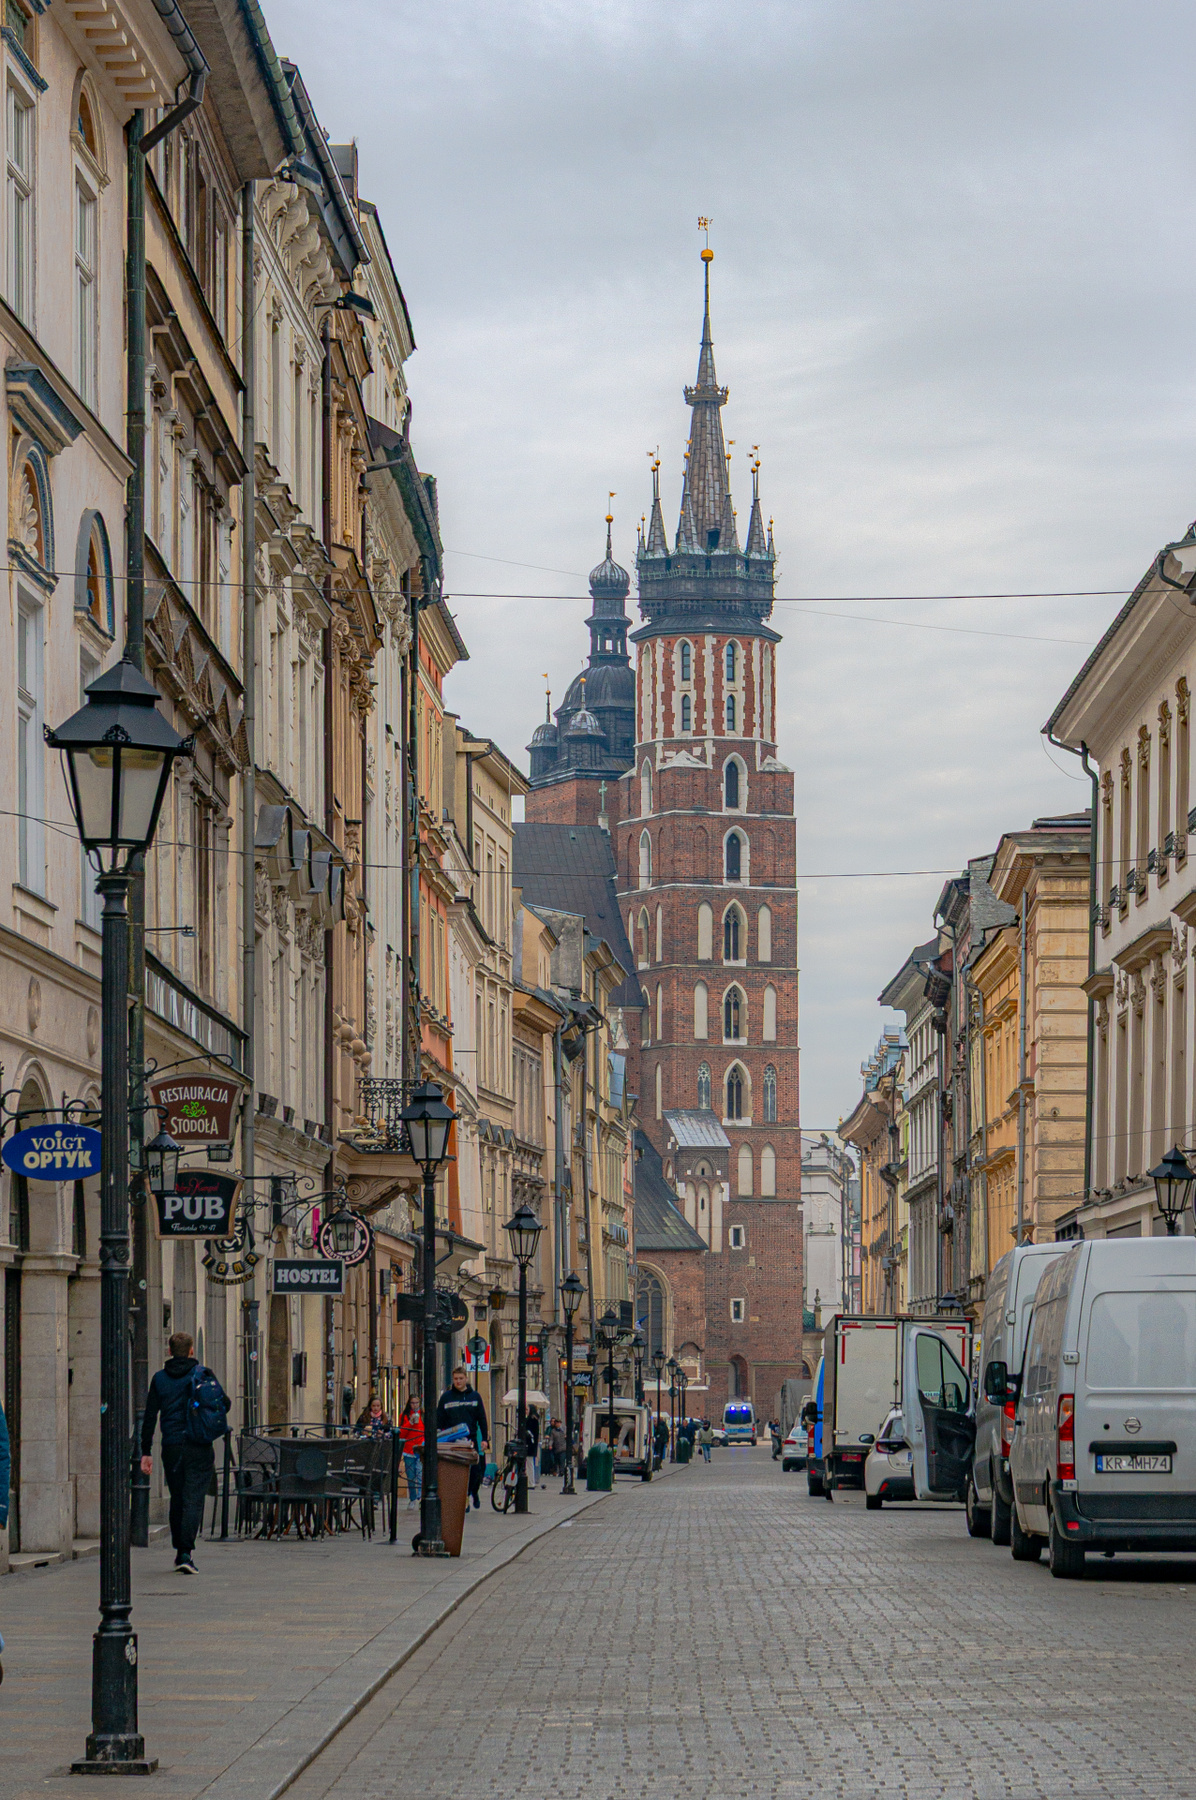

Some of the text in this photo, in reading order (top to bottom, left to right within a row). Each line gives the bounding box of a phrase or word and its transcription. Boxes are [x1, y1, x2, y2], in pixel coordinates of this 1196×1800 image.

[159, 1086, 228, 1104] RESTAURACJA
[170, 1116, 219, 1135] STODOŁA
[23, 1150, 93, 1169] OPTYK
[163, 1196, 226, 1220] PUB
[277, 1268, 340, 1284] HOSTEL
[1105, 1457, 1123, 1469] KR
[1127, 1457, 1167, 1469] 4MH74
